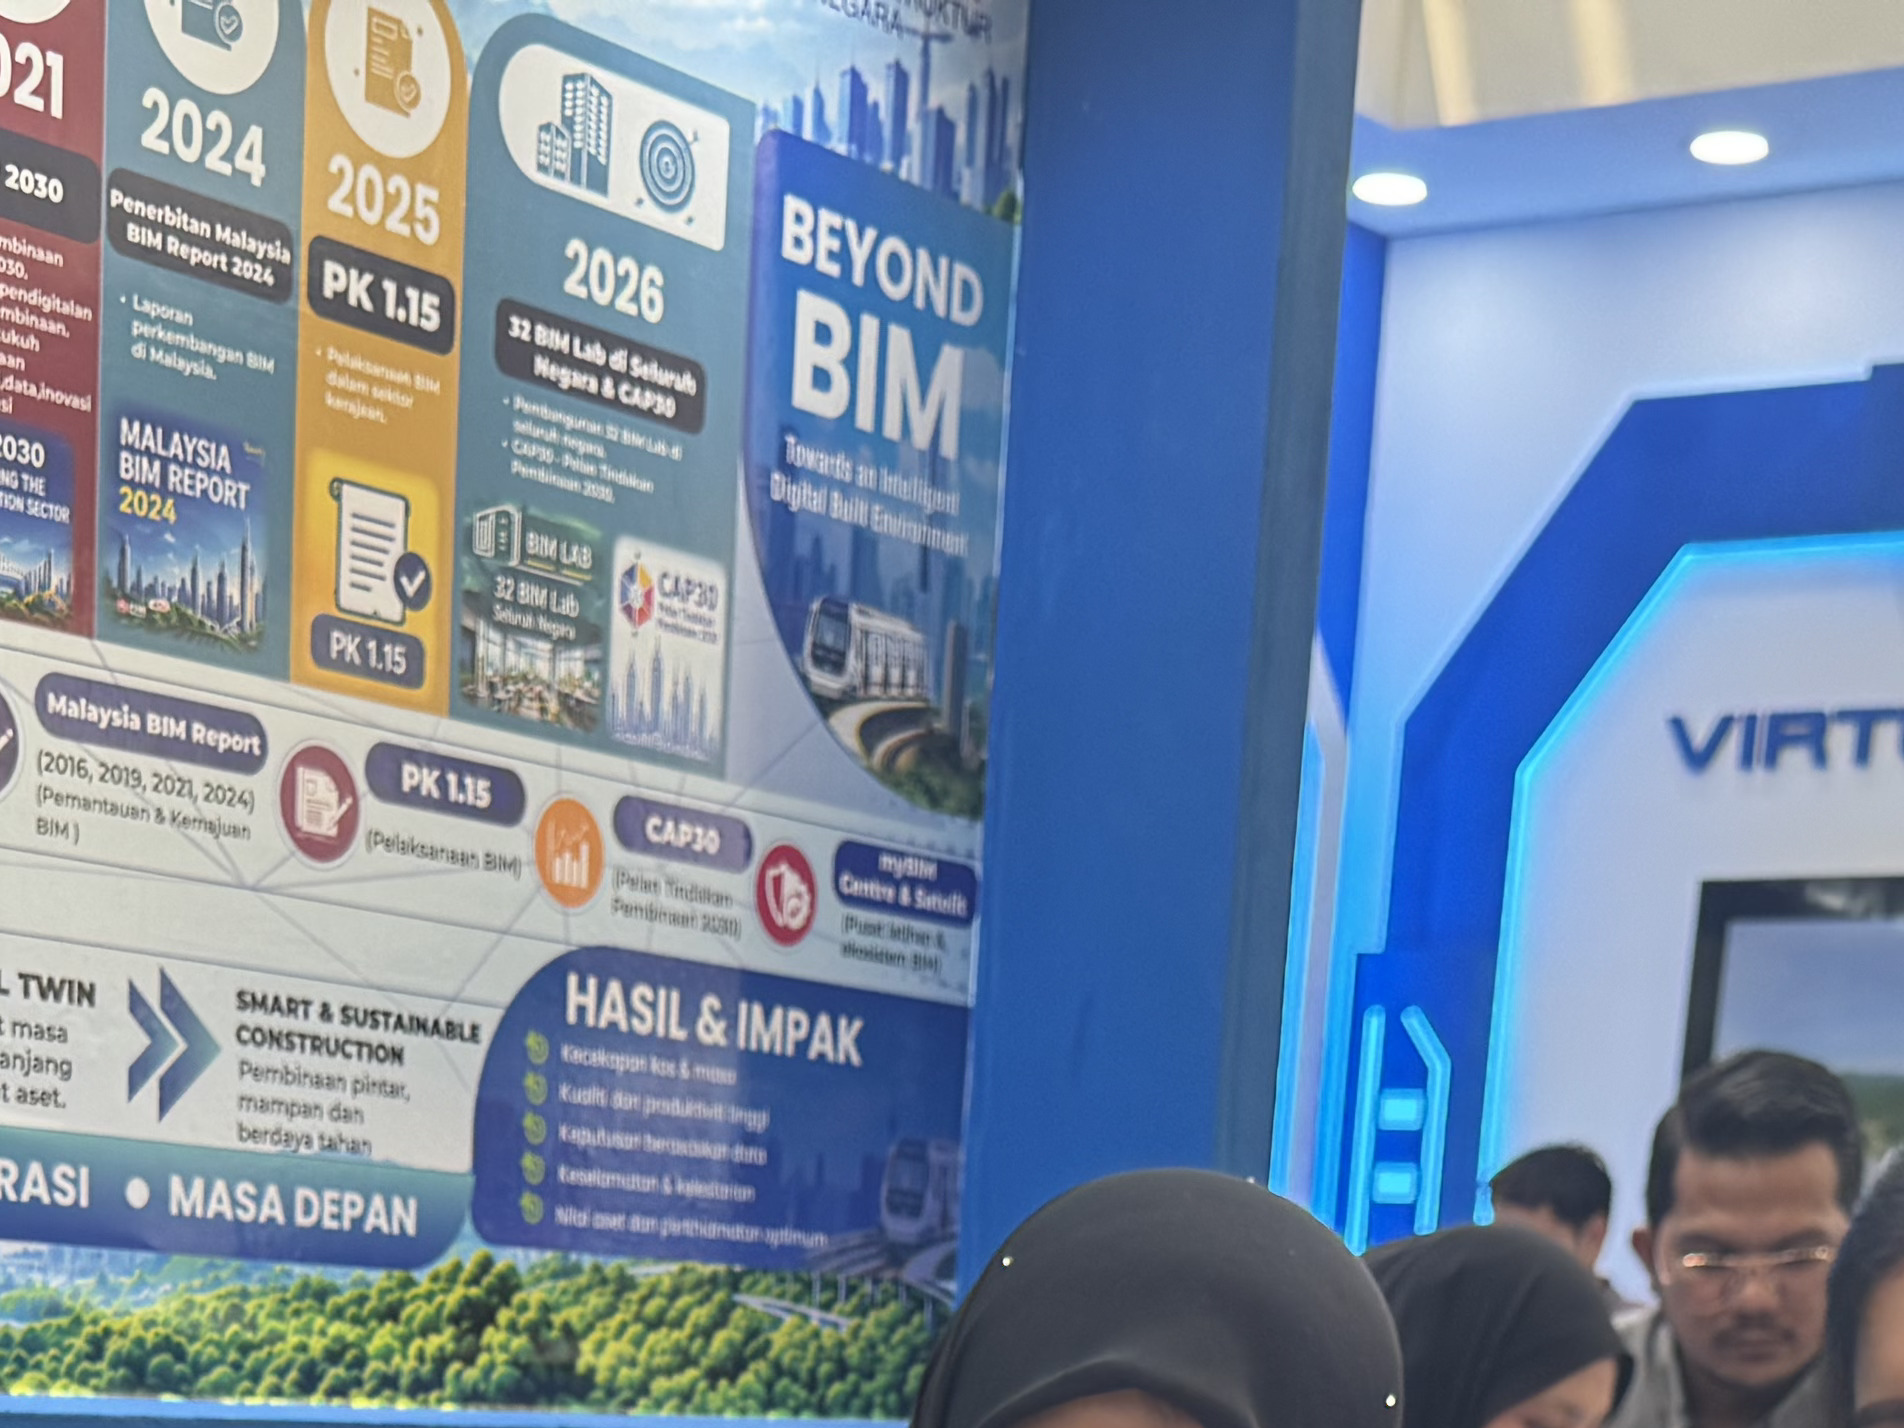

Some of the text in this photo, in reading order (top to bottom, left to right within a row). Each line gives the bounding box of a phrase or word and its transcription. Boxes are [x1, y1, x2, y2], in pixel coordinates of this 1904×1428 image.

[141, 87, 266, 188] 2024
[5, 163, 64, 204] 2030
[327, 153, 440, 246] 2025
[564, 238, 664, 324] 2026
[781, 193, 983, 327] BEYOND
[323, 260, 440, 333] PK 1.15
[792, 288, 966, 462] BIM
[119, 417, 232, 474] MALAYSIA
[21, 472, 46, 497] THE
[119, 452, 250, 510] BIM REPORT
[330, 630, 407, 675] PK 1.15
[36, 748, 94, 782] (2016,
[98, 760, 147, 792] 2019,
[203, 781, 255, 815] 2024)
[401, 761, 492, 809] PK 1.15
[646, 815, 721, 855] CAP30
[20, 971, 96, 1008] TWIN
[565, 970, 688, 1043] HASIL
[697, 992, 729, 1047] &
[736, 1000, 864, 1068] IMPAK
[11, 1017, 68, 1045] masa
[169, 1174, 418, 1238] MASA DEPAN
